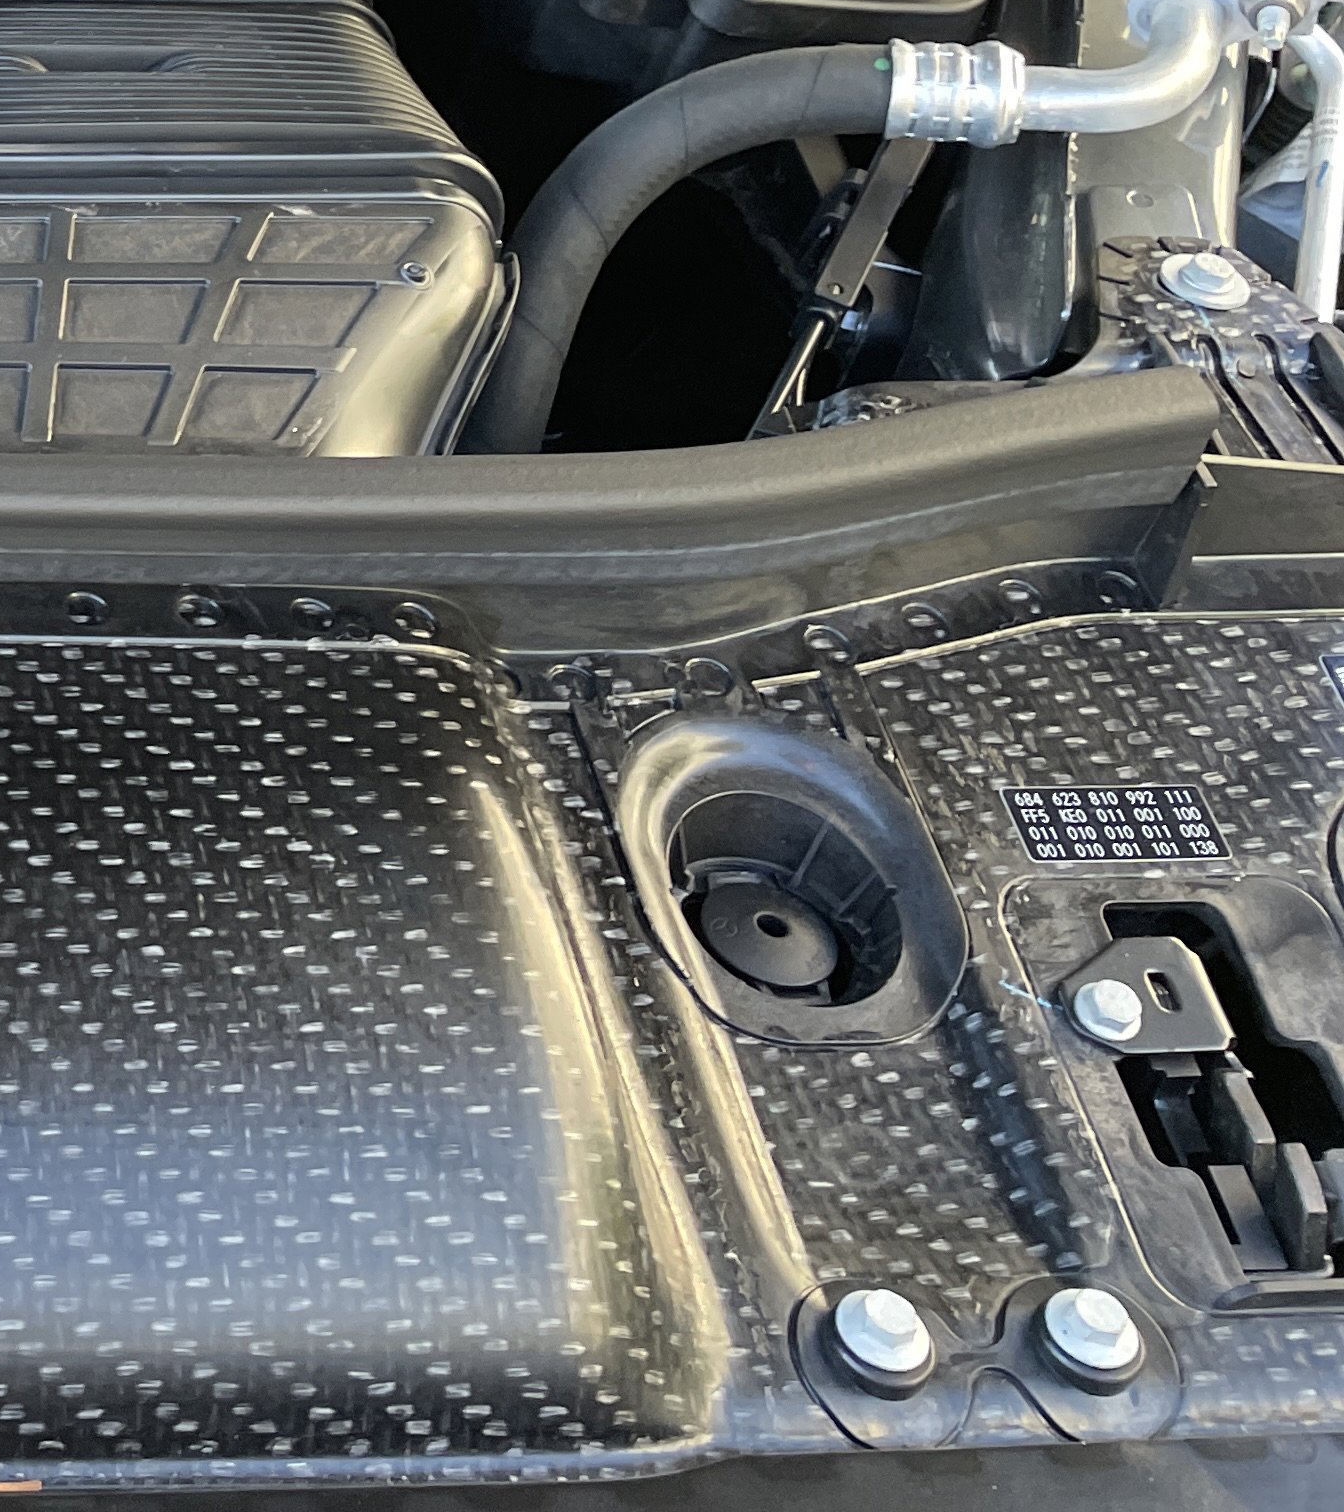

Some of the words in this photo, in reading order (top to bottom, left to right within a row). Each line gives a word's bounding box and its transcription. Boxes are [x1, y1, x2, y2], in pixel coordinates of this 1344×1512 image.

[1014, 792, 1043, 806] 684
[1052, 792, 1081, 806] 623
[1088, 791, 1118, 805] 810
[1125, 791, 1157, 805] 992
[1164, 790, 1192, 803] 111
[1021, 809, 1050, 823] FF5
[1059, 809, 1087, 823] KE0
[1096, 809, 1126, 823] 011
[1134, 808, 1163, 822] 001
[1173, 807, 1202, 821] 100
[1028, 826, 1058, 840] 011
[1066, 826, 1097, 840] 010
[1104, 826, 1135, 840] 010
[1142, 825, 1171, 839] 011
[1179, 823, 1210, 838] 000
[1037, 844, 1066, 857] 001
[1074, 843, 1105, 857] 010
[1112, 842, 1142, 856] 001
[1152, 842, 1180, 855] 101
[1189, 841, 1219, 855] 138
